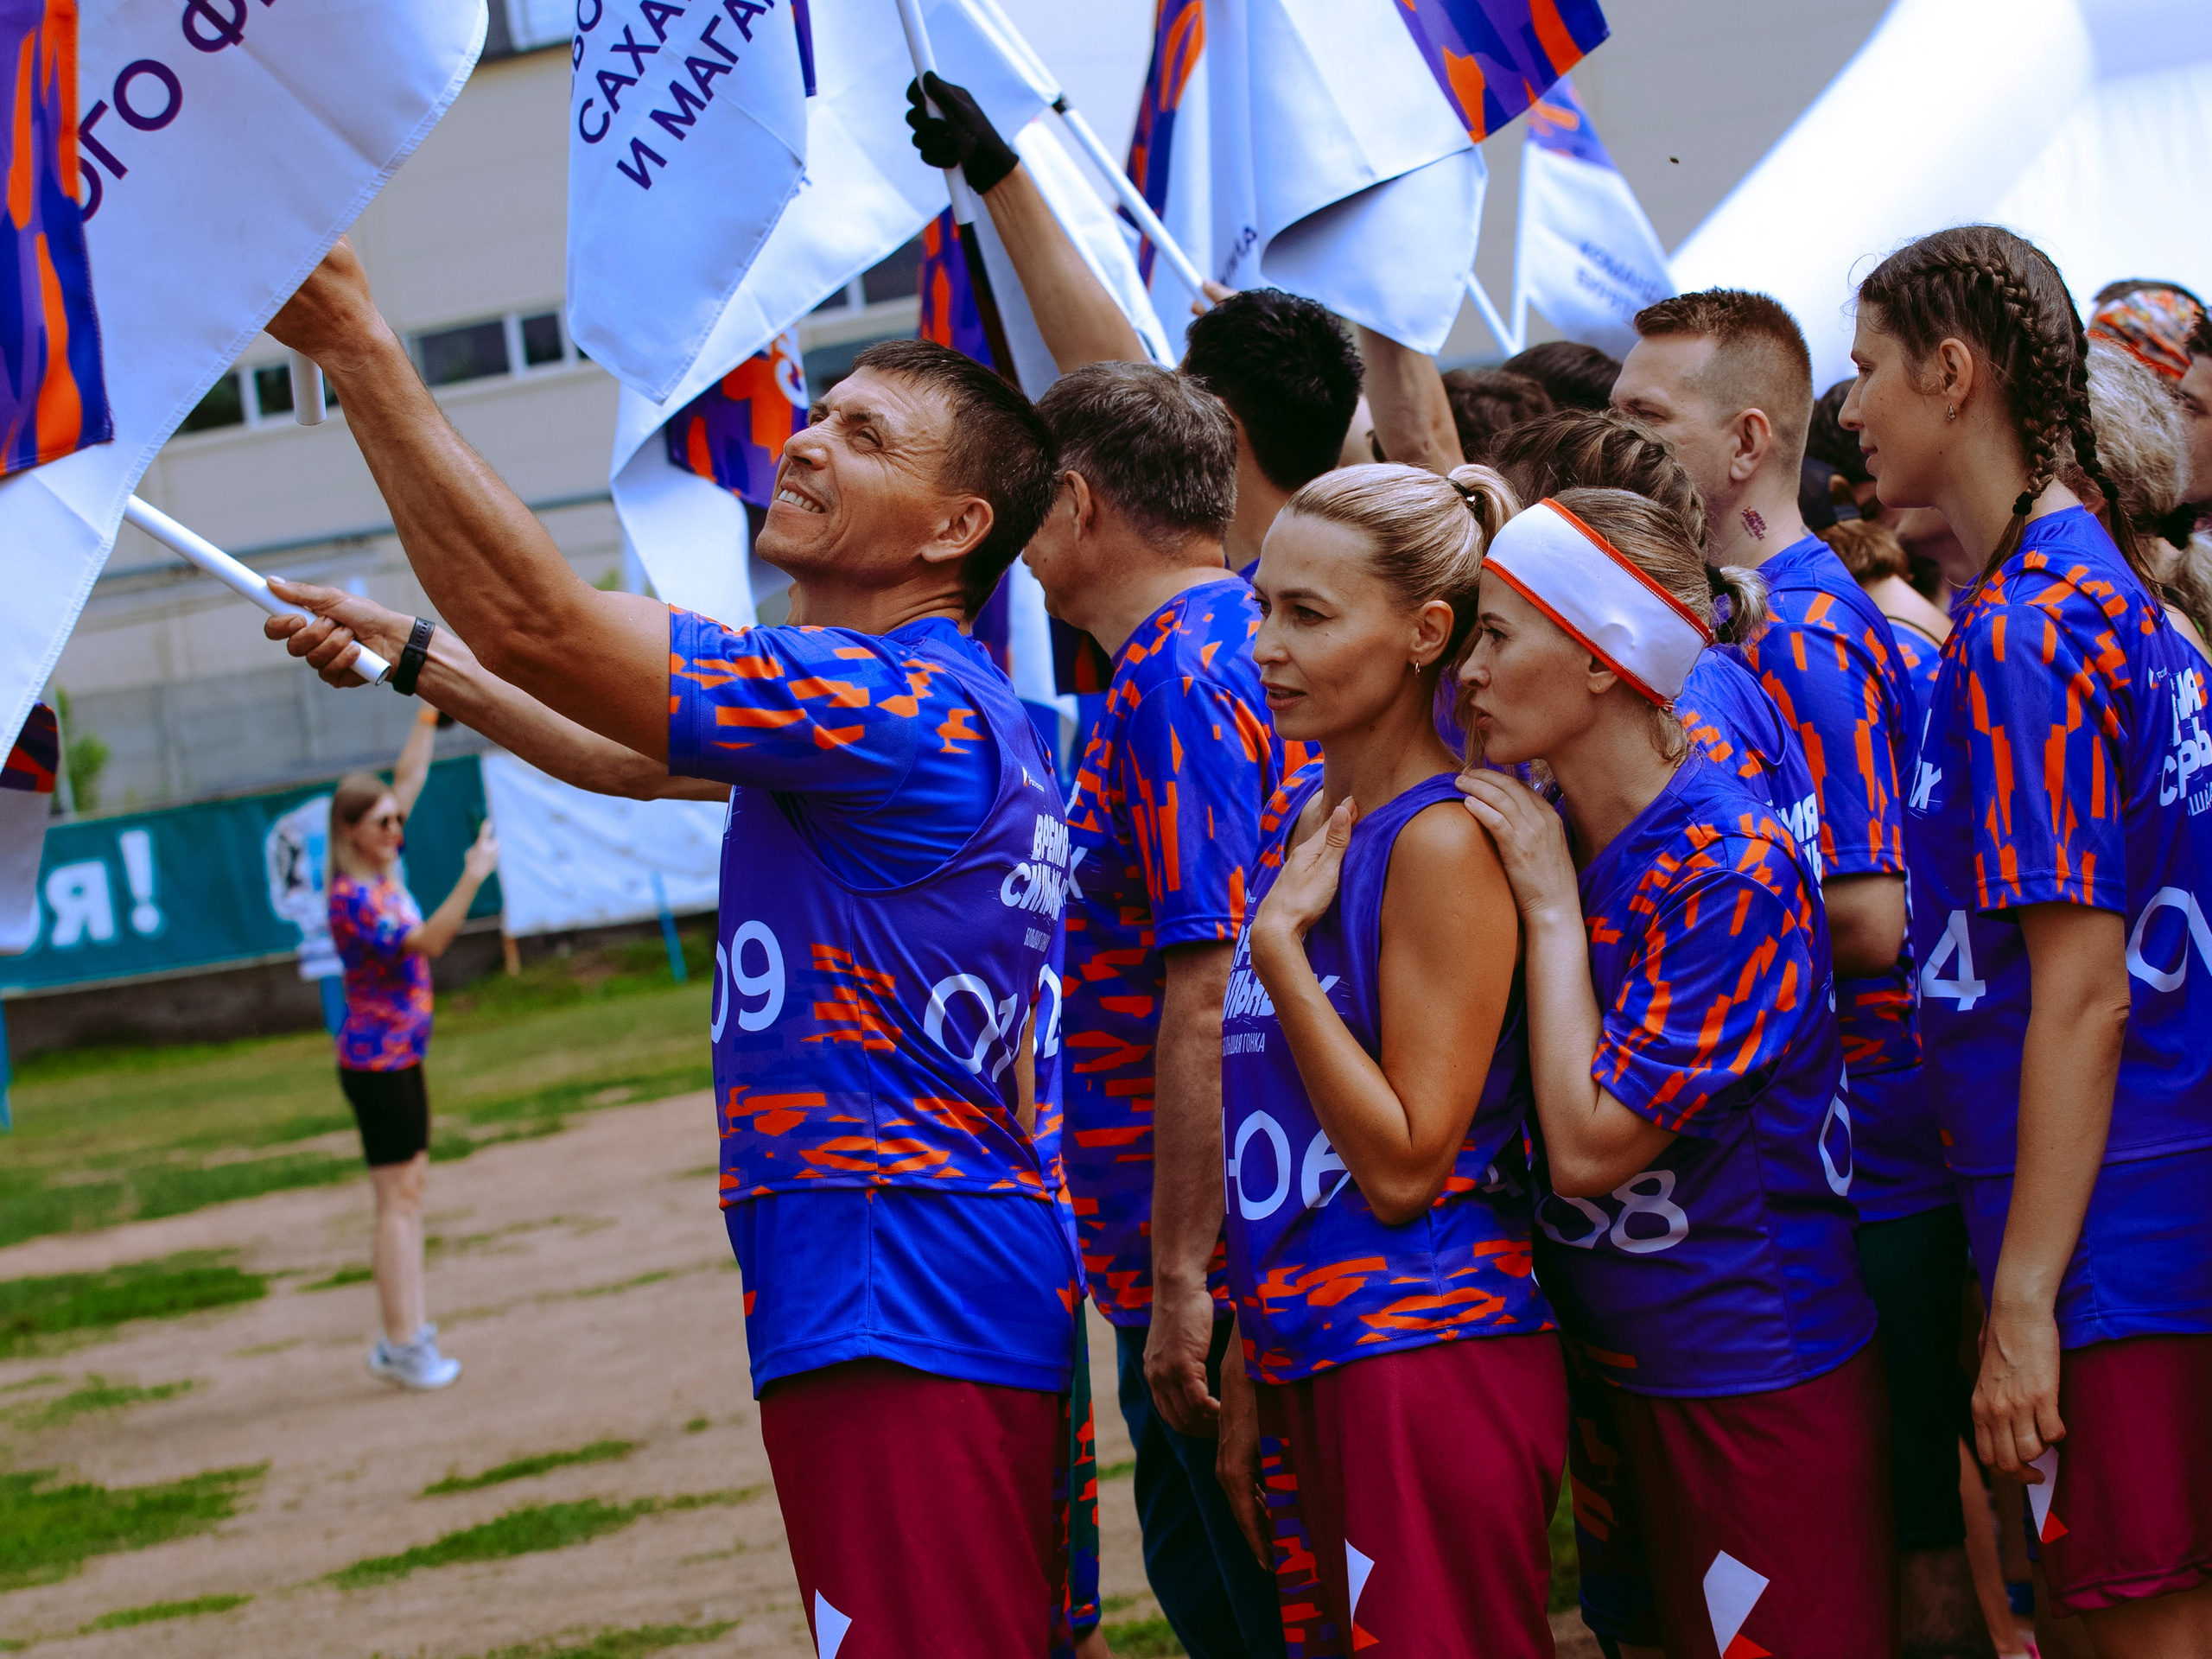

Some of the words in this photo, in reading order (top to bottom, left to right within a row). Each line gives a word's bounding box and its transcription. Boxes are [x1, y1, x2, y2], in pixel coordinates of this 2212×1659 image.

[579, 0, 690, 144] САХА
[616, 137, 668, 190] И
[649, 0, 775, 141] МАГА
[1031, 814, 1069, 868] ВРЕМЯ
